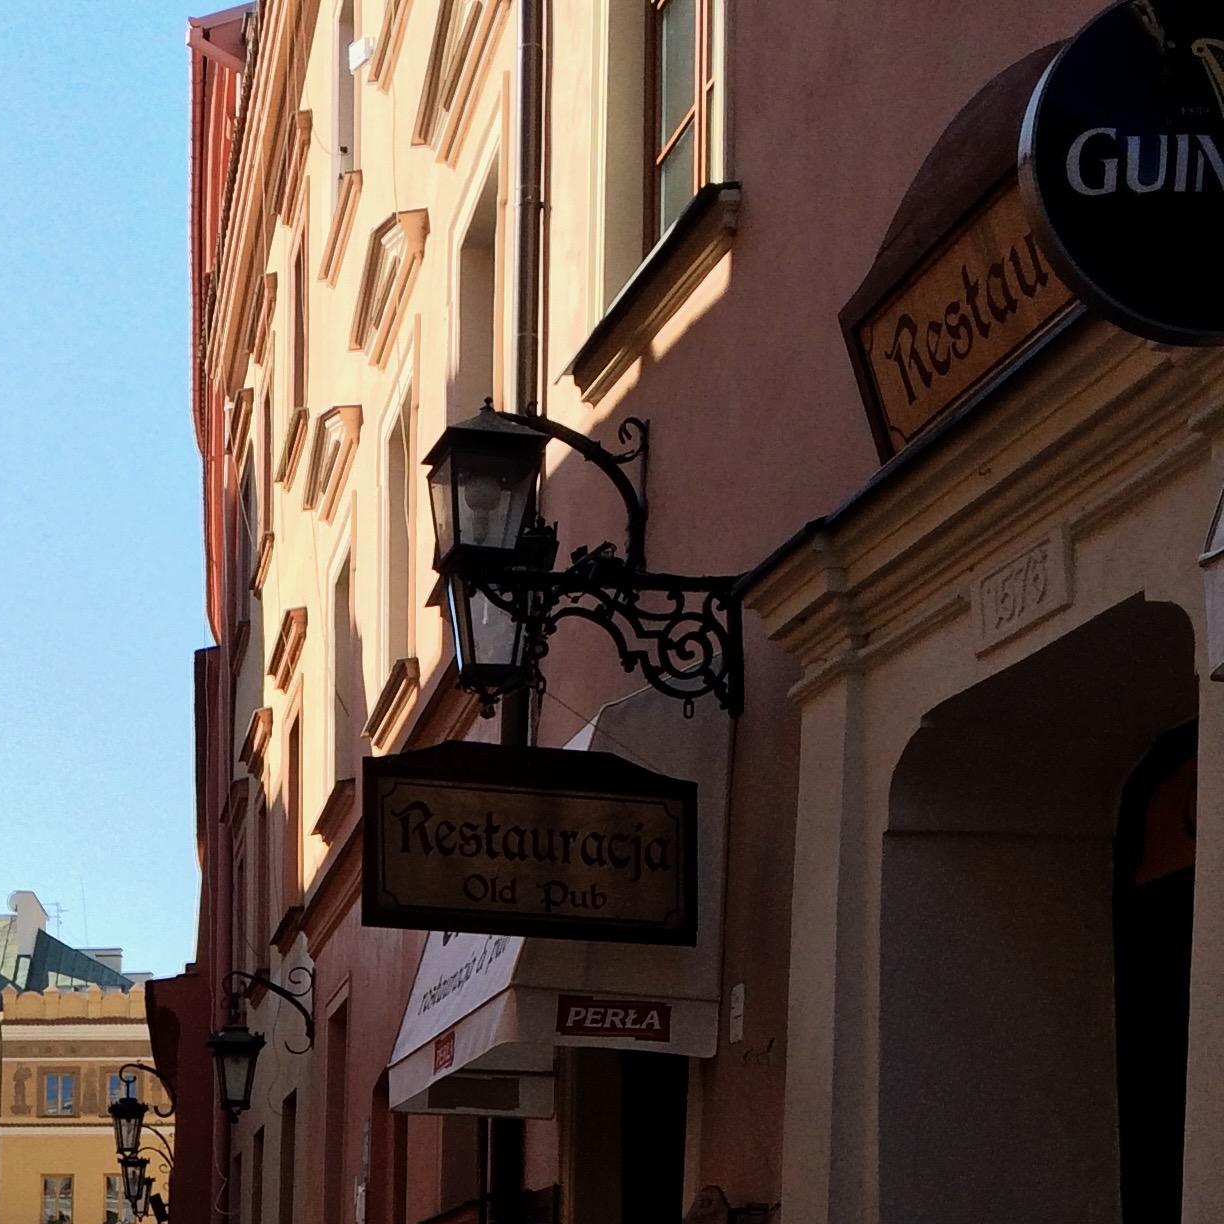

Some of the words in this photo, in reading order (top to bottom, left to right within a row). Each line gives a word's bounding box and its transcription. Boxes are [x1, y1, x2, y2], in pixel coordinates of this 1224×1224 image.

[1065, 127, 1224, 195] GUIN
[885, 232, 1049, 406] Restau
[390, 801, 671, 882] Restauracja
[463, 874, 517, 904] Old
[536, 880, 608, 912] Pub
[565, 1006, 661, 1030] PERŁA
